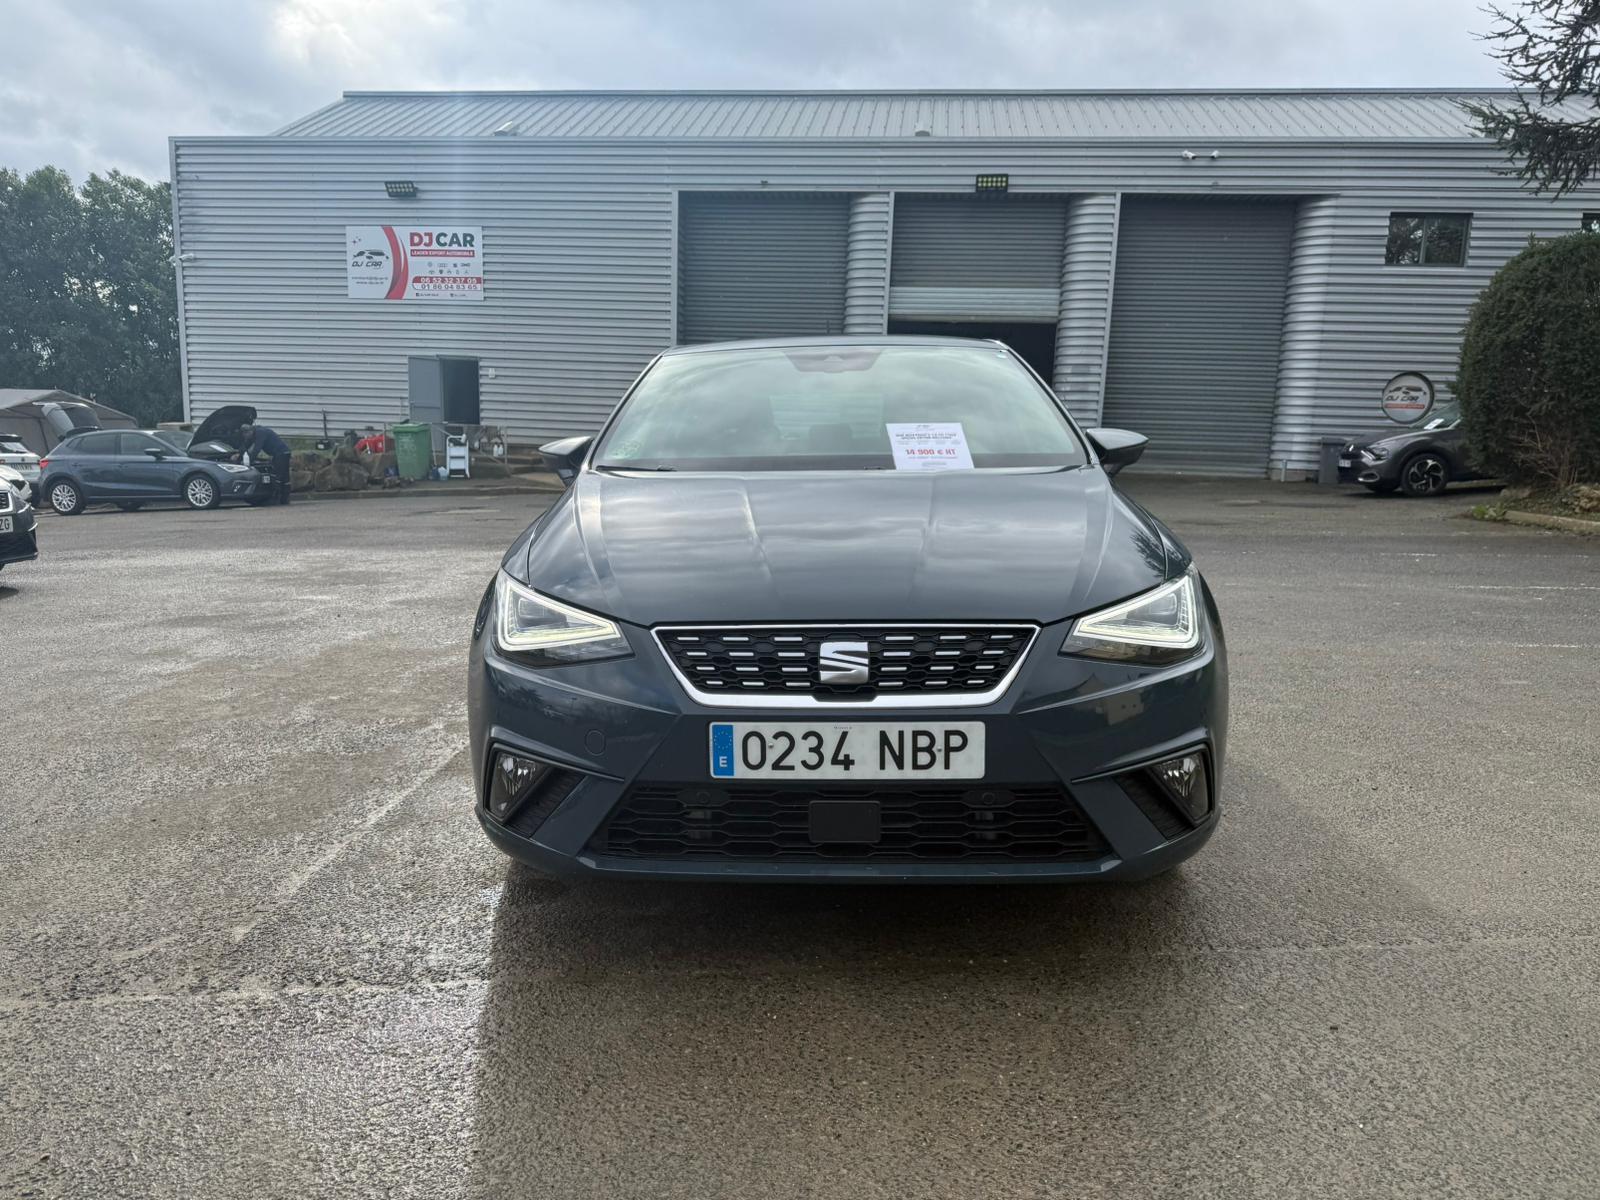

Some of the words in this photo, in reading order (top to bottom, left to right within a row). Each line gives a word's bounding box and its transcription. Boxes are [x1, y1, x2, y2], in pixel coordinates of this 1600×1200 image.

[719, 756, 728, 767] E
[741, 730, 855, 771] 0234
[879, 730, 969, 770] NBP
